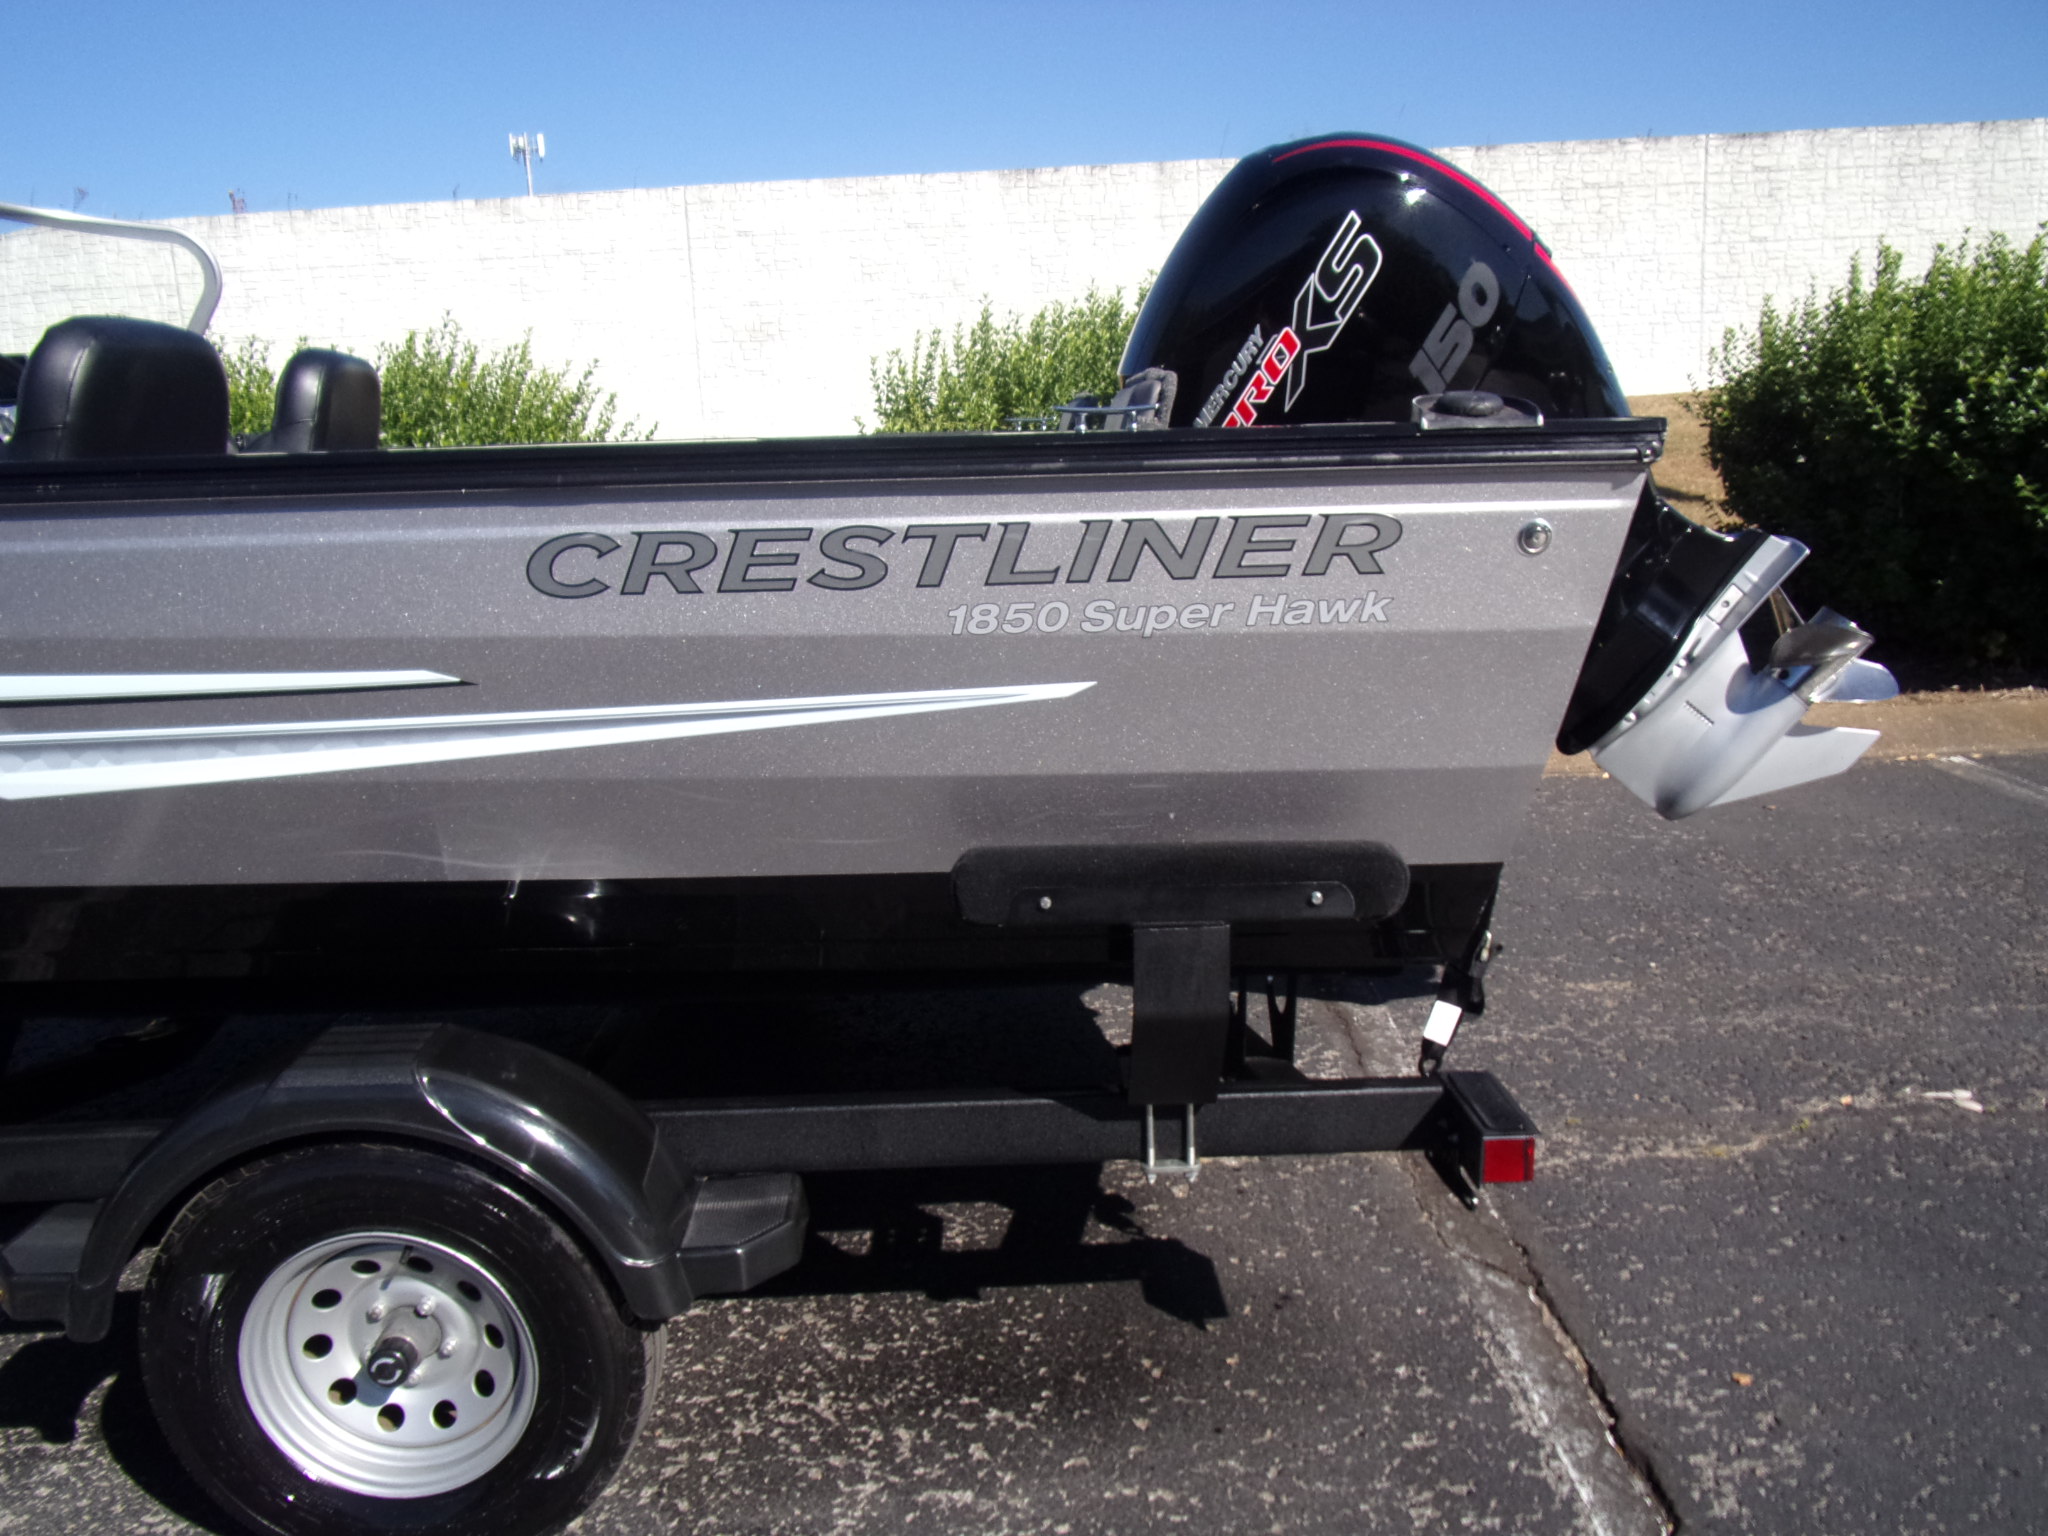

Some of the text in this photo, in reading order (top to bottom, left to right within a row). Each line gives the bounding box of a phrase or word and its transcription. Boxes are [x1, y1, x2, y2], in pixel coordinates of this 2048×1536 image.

[1409, 261, 1499, 394] 150
[1221, 326, 1301, 428] RO
[526, 513, 1403, 599] CRESTLINER
[948, 590, 1396, 638] 1850 Super Hawk
